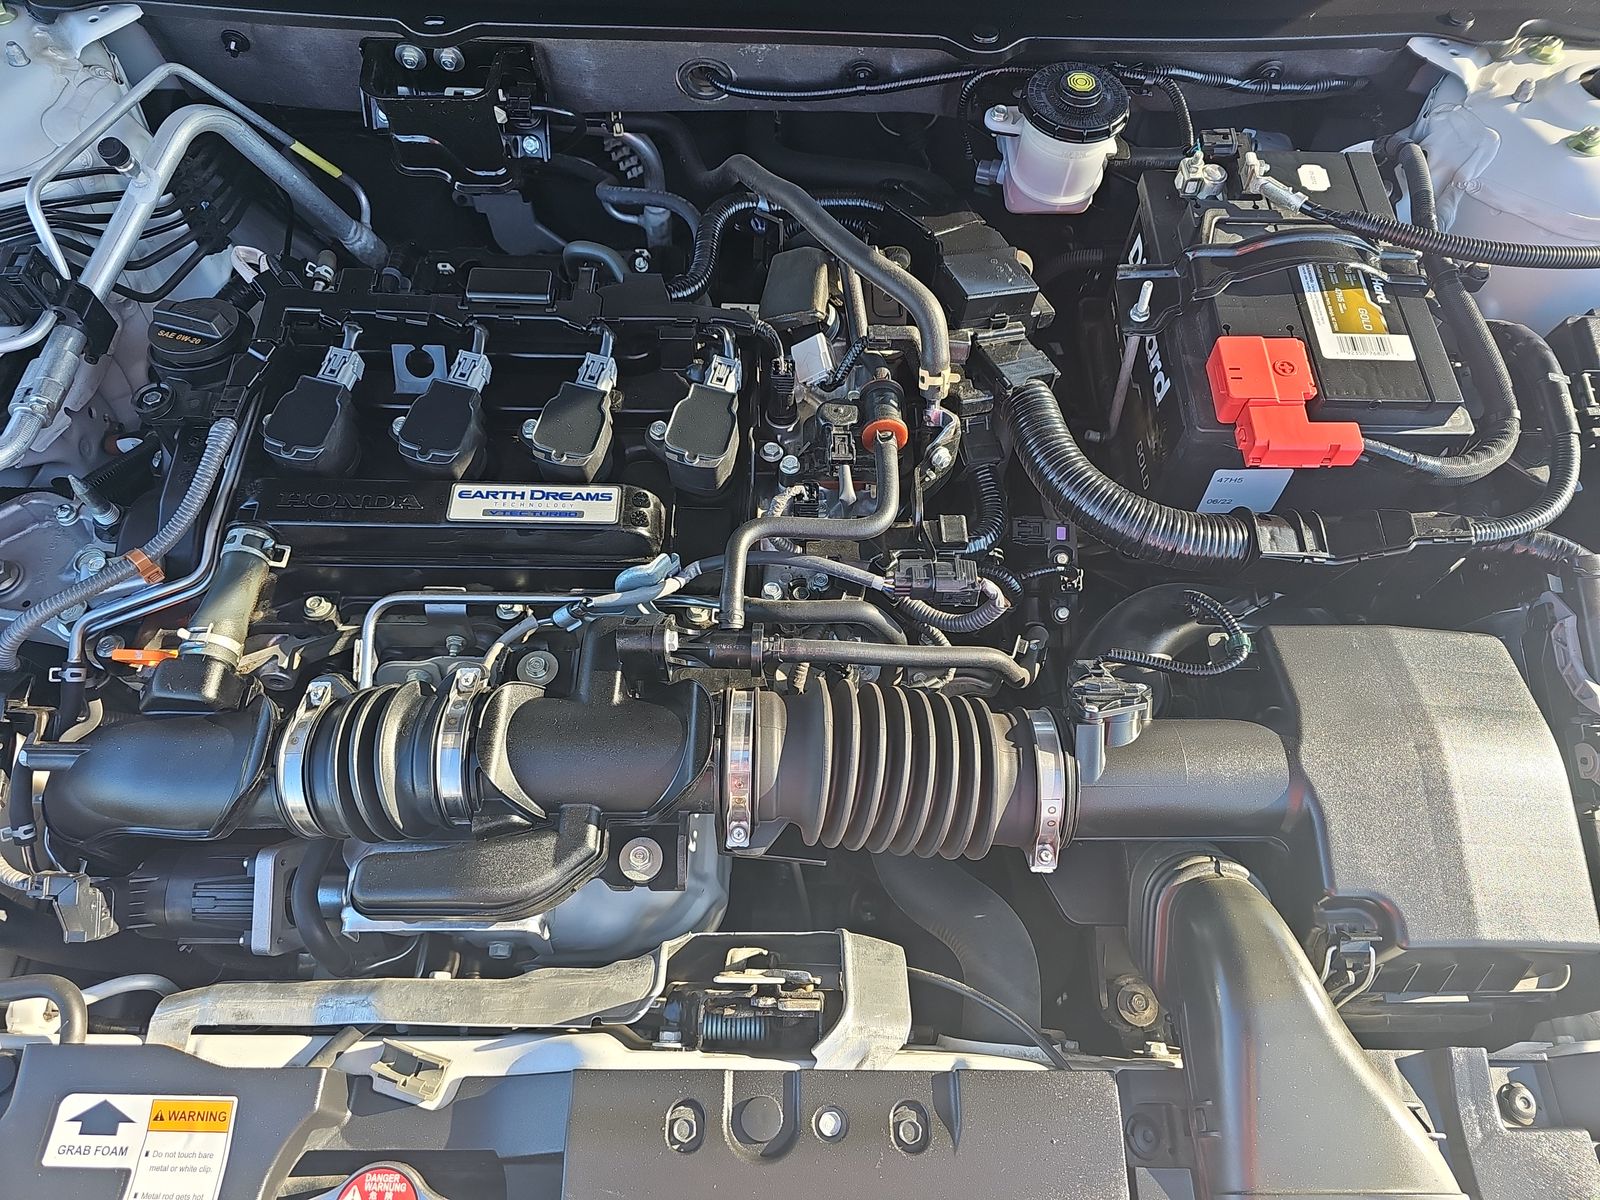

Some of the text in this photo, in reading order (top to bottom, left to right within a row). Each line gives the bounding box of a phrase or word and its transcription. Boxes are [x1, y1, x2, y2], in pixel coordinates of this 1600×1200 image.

[1358, 307, 1373, 331] GOLD
[157, 330, 177, 339] SAE
[1136, 440, 1150, 490] GOLD
[458, 490, 526, 500] EARTH
[276, 492, 424, 510] HONDA
[168, 1110, 228, 1122] WARNING
[57, 1144, 129, 1157] GRAB FOAM
[152, 1150, 163, 1158] Do
[177, 1151, 197, 1159] touch
[198, 1151, 215, 1159] bare
[149, 1164, 170, 1172] metal
[179, 1165, 198, 1173] white
[365, 1173, 401, 1183] DANGER
[364, 1182, 407, 1192] WARNUNG
[140, 1192, 161, 1200] Metal
